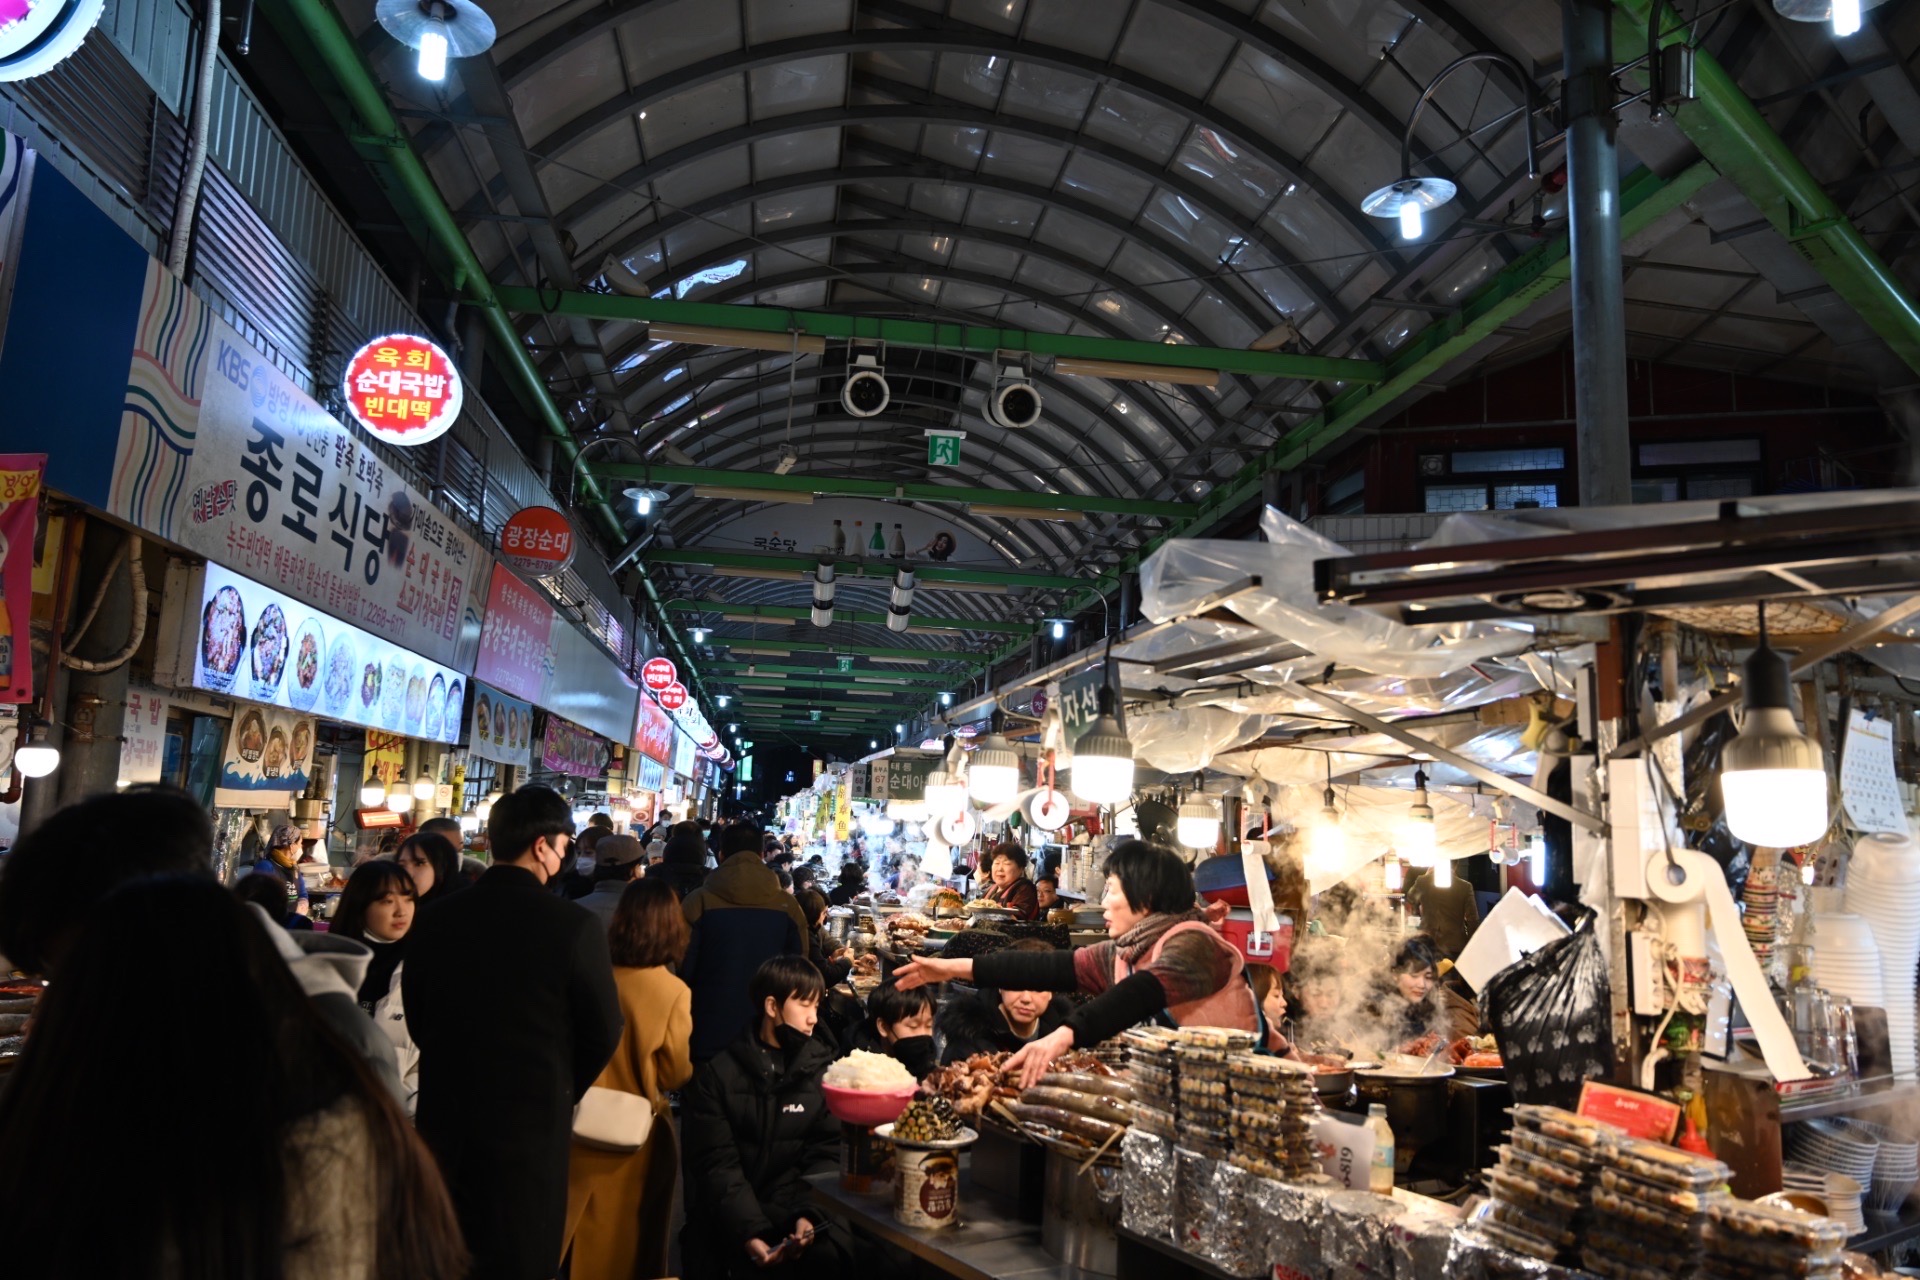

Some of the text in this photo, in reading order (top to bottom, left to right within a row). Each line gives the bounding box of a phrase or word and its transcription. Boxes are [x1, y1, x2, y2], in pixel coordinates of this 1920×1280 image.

[355, 368, 447, 399] 순대국밥
[216, 339, 252, 391] KBS
[267, 380, 291, 422] 방영
[355, 452, 384, 500] 호박죽
[364, 396, 432, 421] 빈대떡
[240, 416, 391, 586] 종로식당
[506, 525, 570, 554] 광장순대
[226, 519, 273, 576] 녹두빈대떡
[273, 544, 306, 592] 해물파전
[874, 775, 886, 784] 67
[876, 786, 884, 794] 호
[889, 774, 929, 792] 순대아
[782, 1103, 805, 1113] FILA
